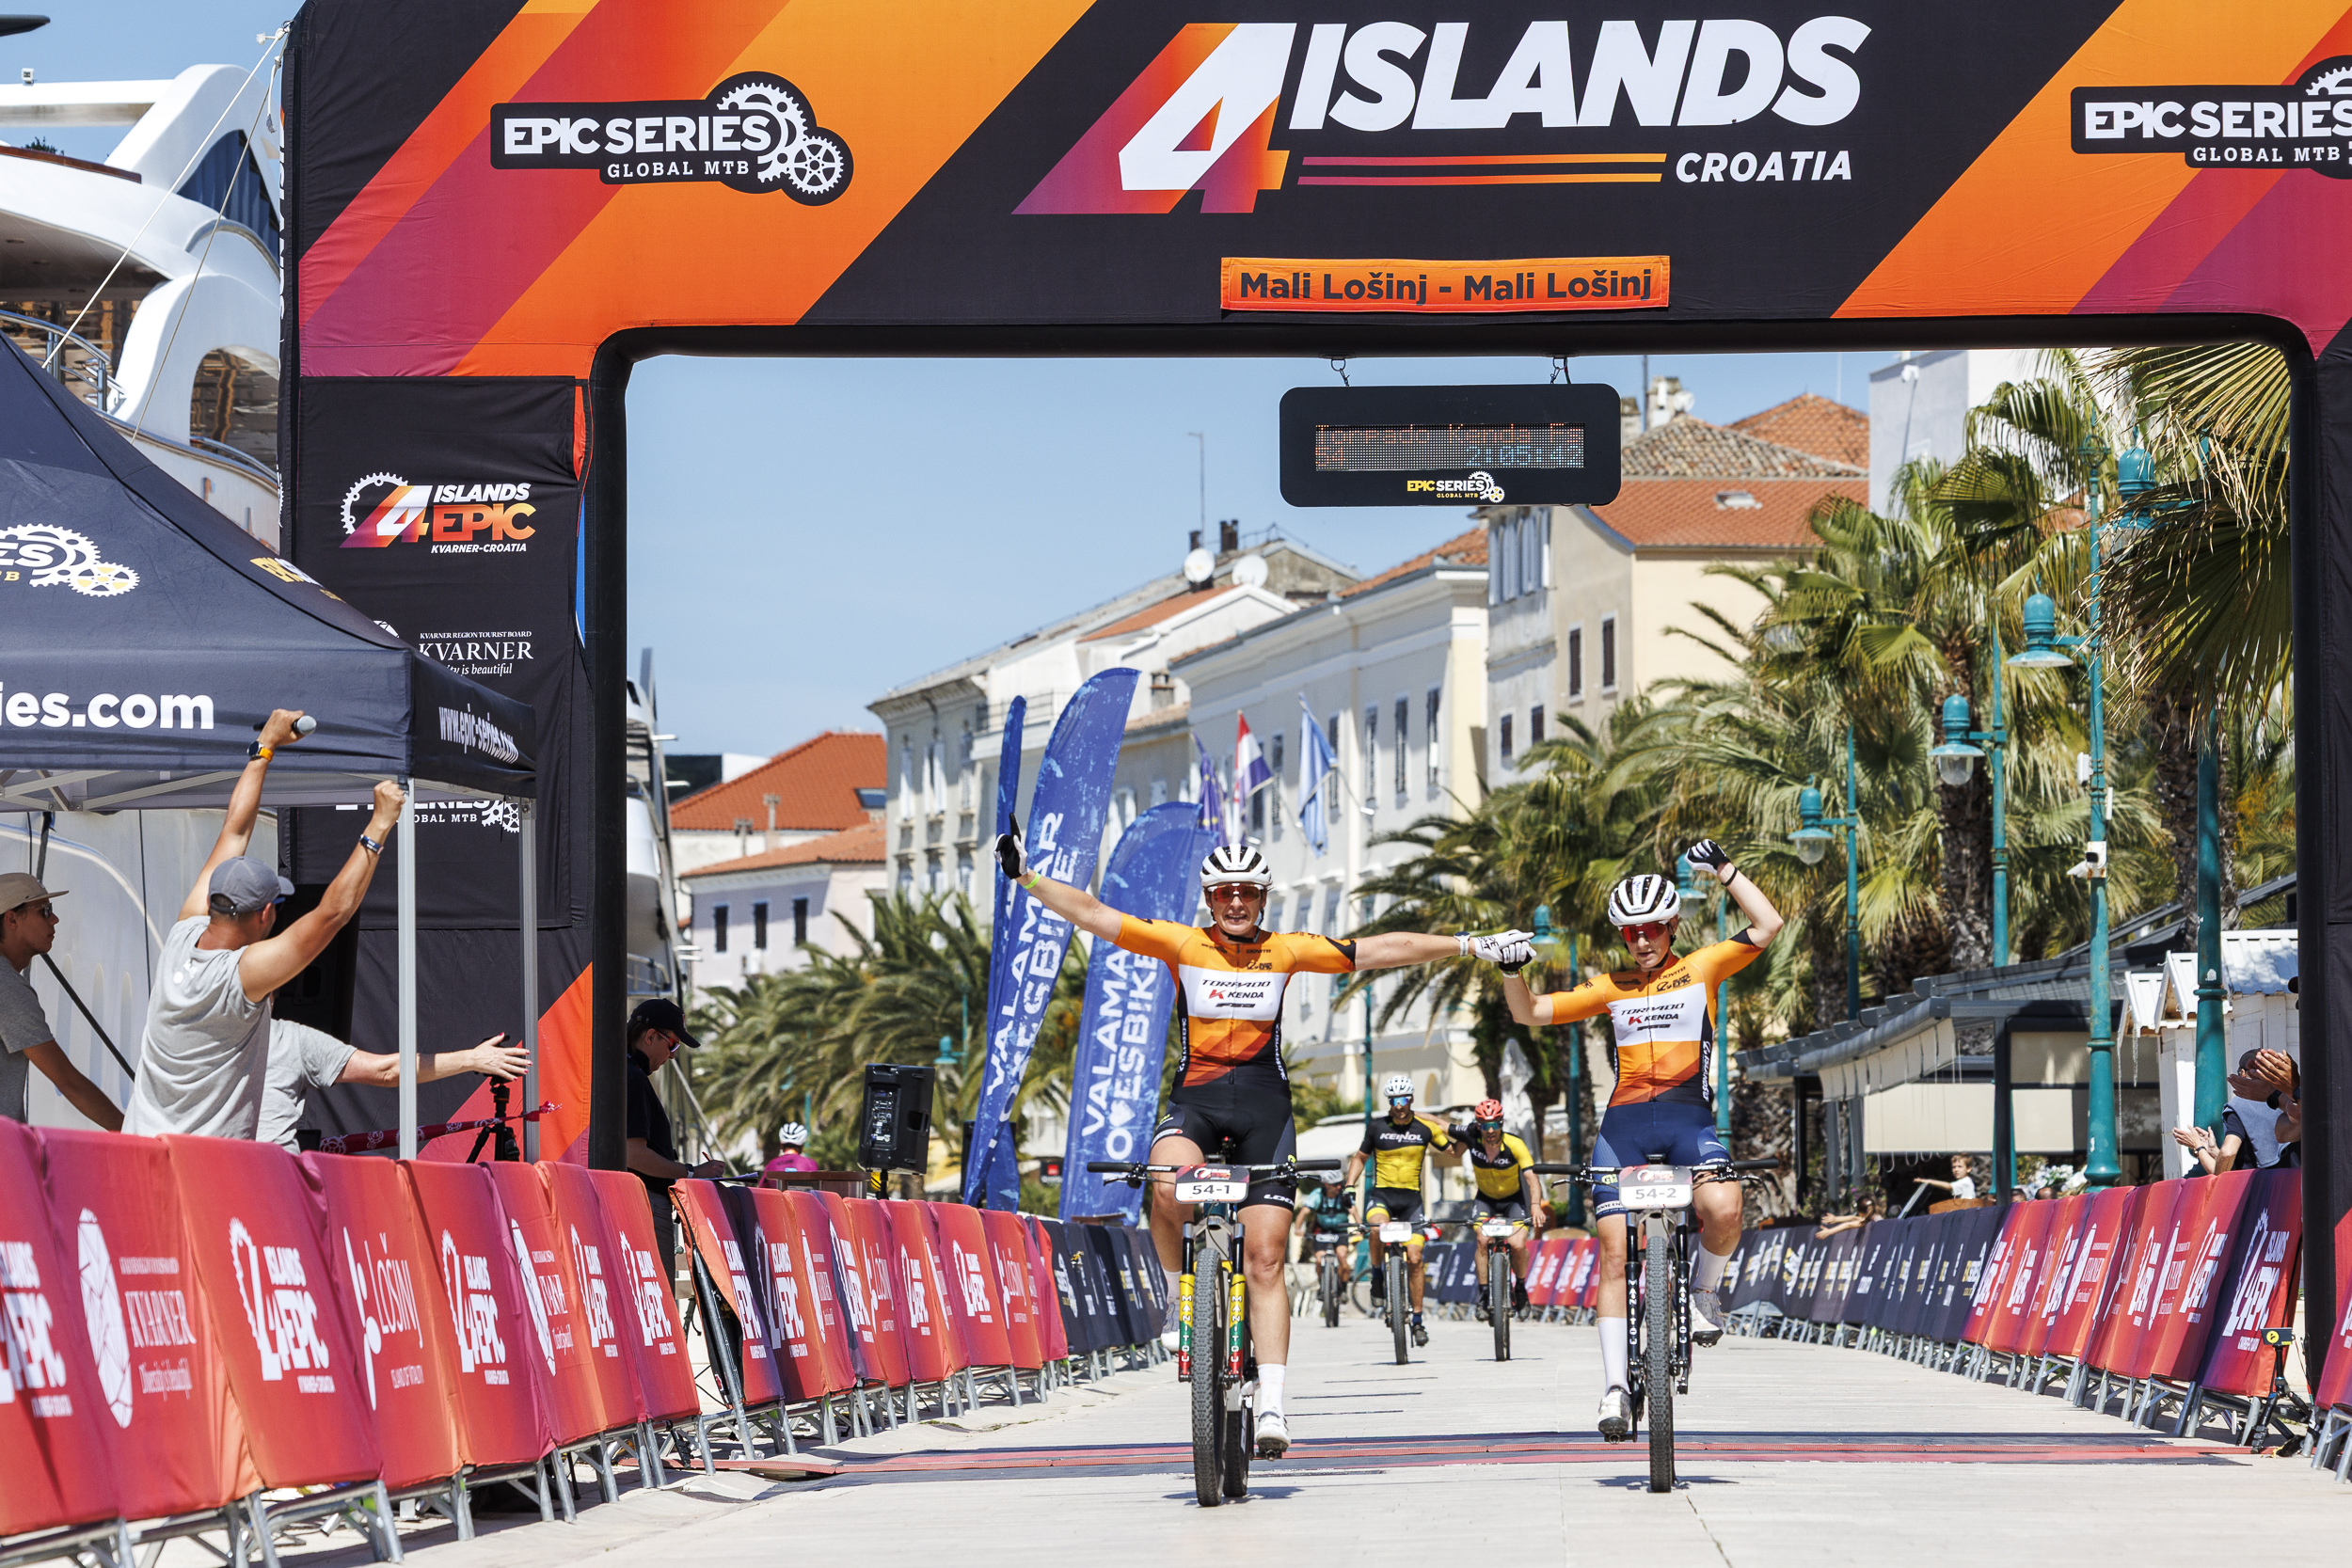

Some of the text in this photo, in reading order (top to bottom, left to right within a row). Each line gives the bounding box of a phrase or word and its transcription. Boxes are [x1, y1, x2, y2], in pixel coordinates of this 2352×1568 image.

[1290, 16, 1872, 132] ISLANDS
[2085, 99, 2352, 139] EPIC SERIES
[504, 115, 771, 155] EPIC SERIES
[2192, 146, 2341, 163] GLOBAL MTB
[607, 160, 750, 179] GLOBAL MTB
[1676, 150, 1853, 183] CROATIA
[1240, 271, 1311, 299] Mali
[1323, 271, 1427, 306] Lošinj
[1463, 271, 1534, 301] Mali
[1547, 269, 1652, 301] Lošinj
[433, 483, 532, 503] ISLANDS
[1406, 480, 1485, 492] EPIC SERIES
[432, 502, 537, 542] EPIC
[431, 543, 527, 554] KVARNER-CROATIA
[508, 630, 532, 639] BOARD
[419, 641, 533, 660] KVARNER
[471, 662, 513, 677] beautiful
[0, 682, 215, 730] es.com
[414, 814, 478, 823] OBAL MTB
[1227, 990, 1263, 999] KENDA
[1644, 1013, 1678, 1022] KENDA
[1082, 950, 1131, 1136] VALAMA
[1379, 1131, 1422, 1142] KEINOL
[1192, 1184, 1230, 1195] 54-1
[1635, 1187, 1676, 1199] 54-2
[274, 1289, 329, 1370] EPIC
[1181, 1295, 1193, 1362] MANITOU
[1231, 1295, 1243, 1362] MANITOU
